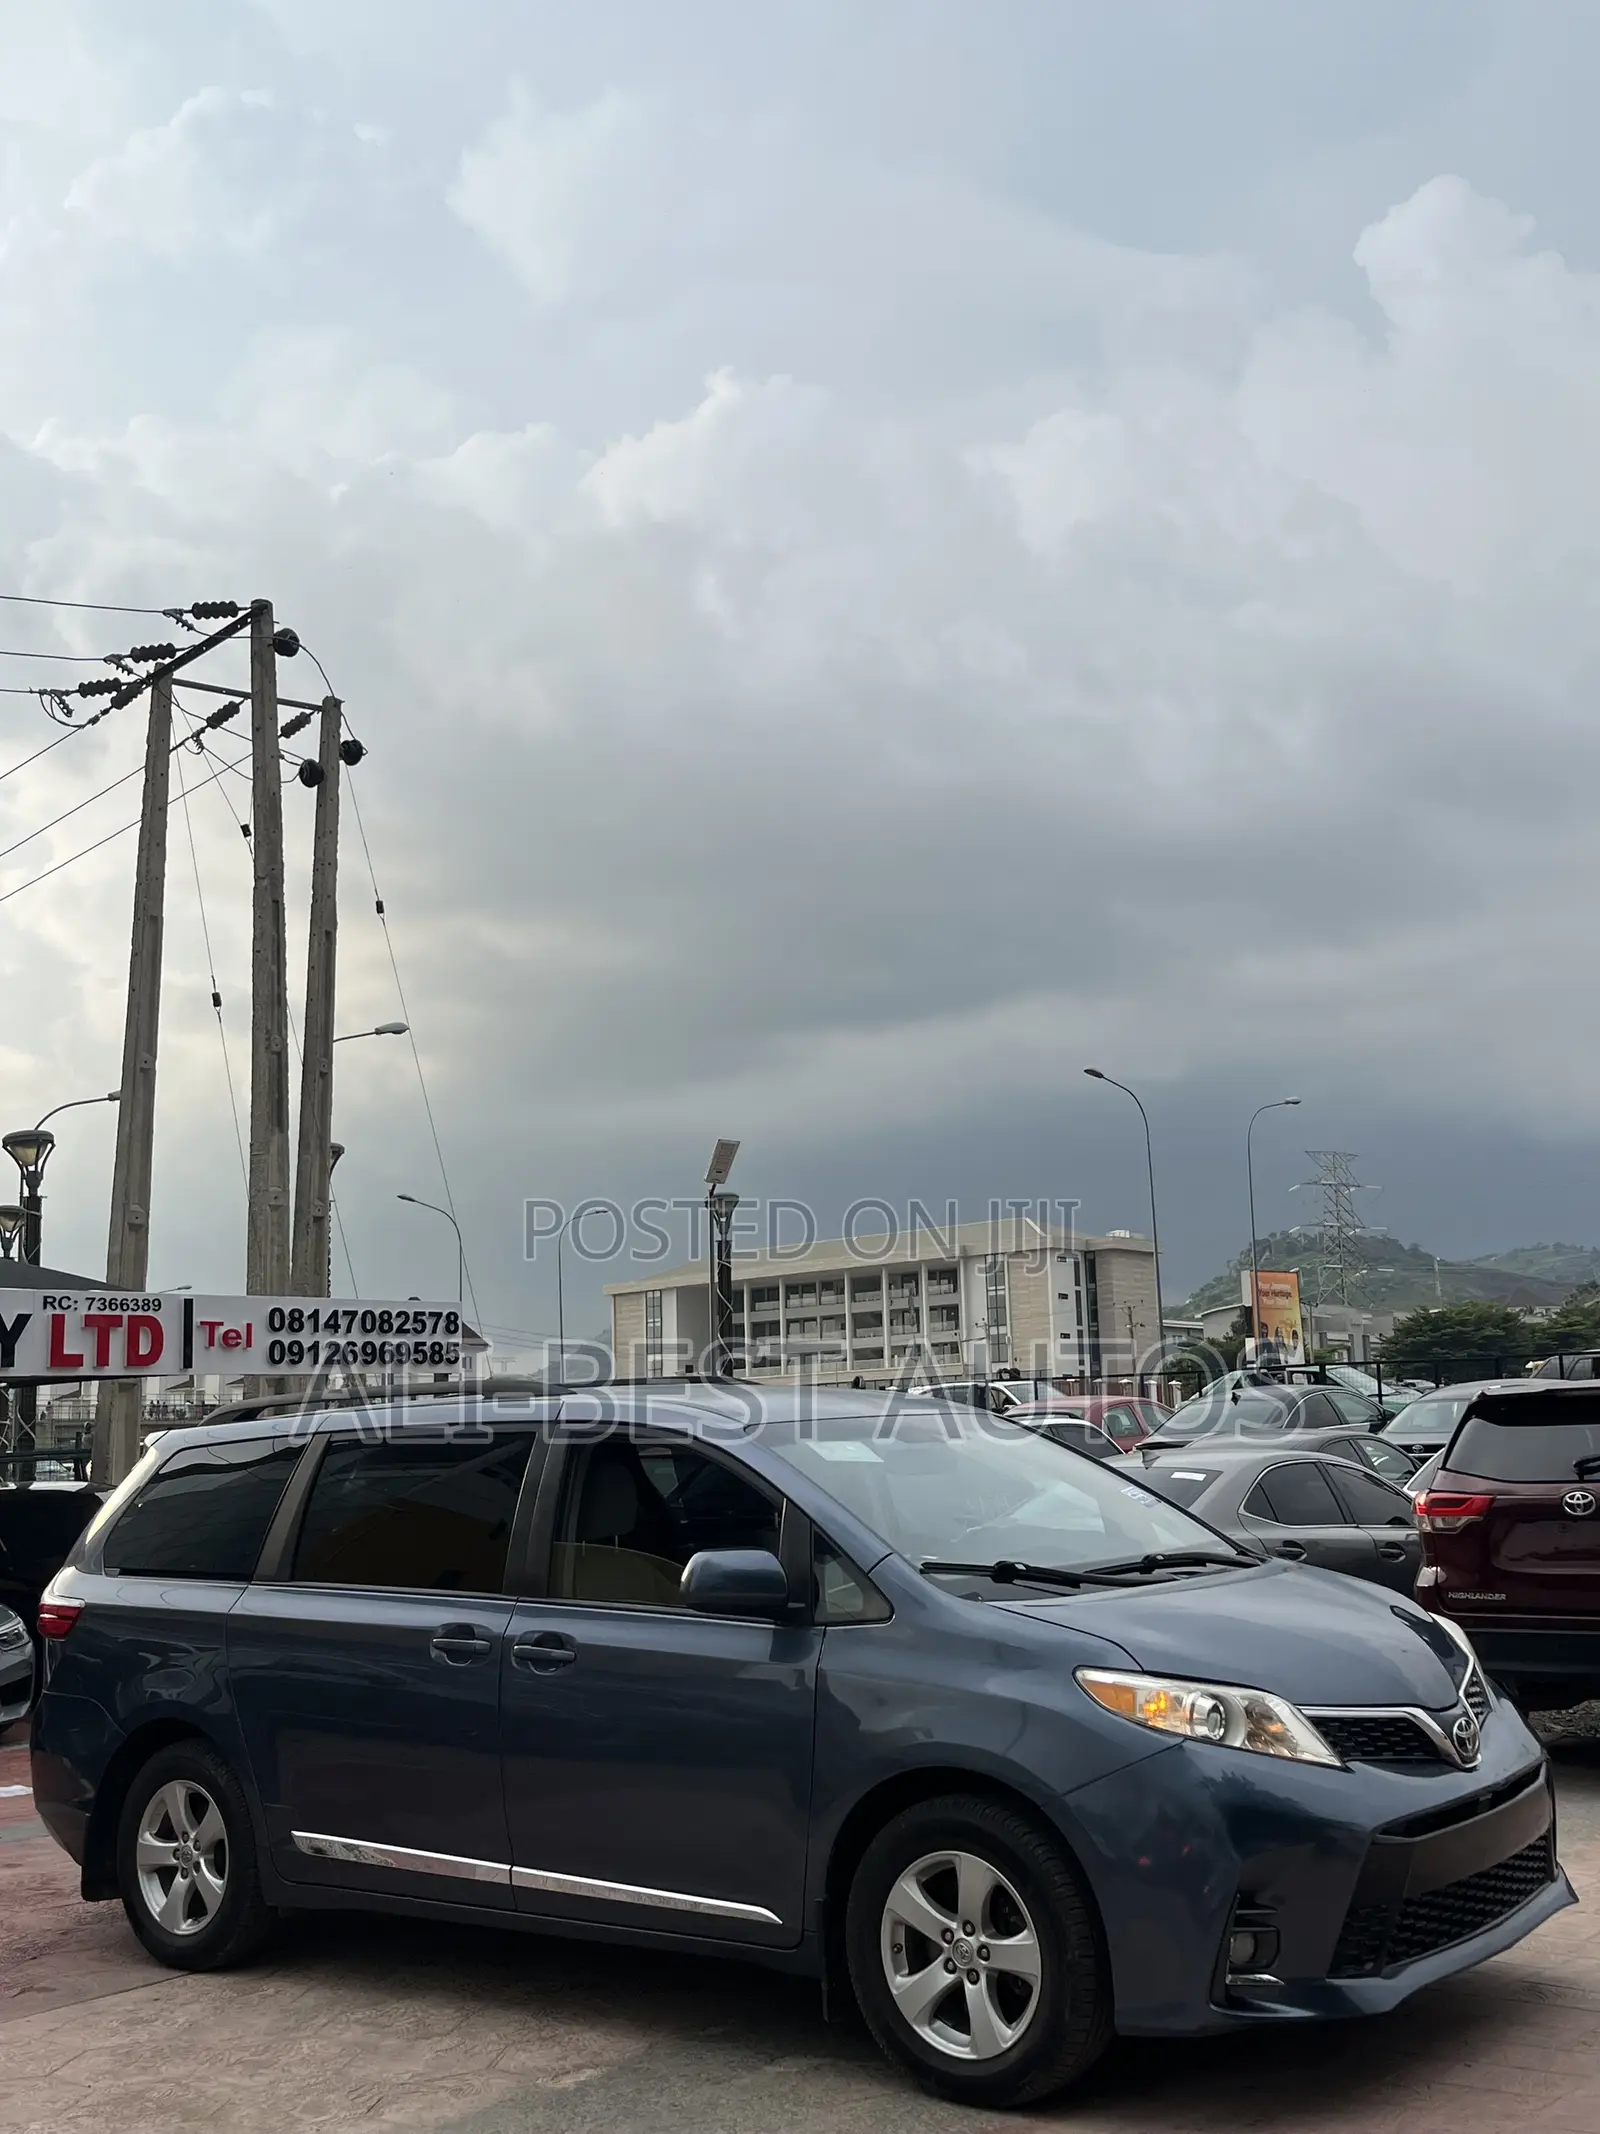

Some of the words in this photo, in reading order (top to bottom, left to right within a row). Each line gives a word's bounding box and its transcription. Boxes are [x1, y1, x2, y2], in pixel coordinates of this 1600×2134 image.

[42, 1295, 78, 1311] RC:
[85, 1297, 162, 1312] 7366389
[198, 1320, 253, 1349] Tel
[267, 1307, 460, 1335] 08147082578
[49, 1313, 164, 1368] LTD
[267, 1339, 460, 1366] 09126969585
[1448, 1591, 1507, 1600] HIGHLANDER
